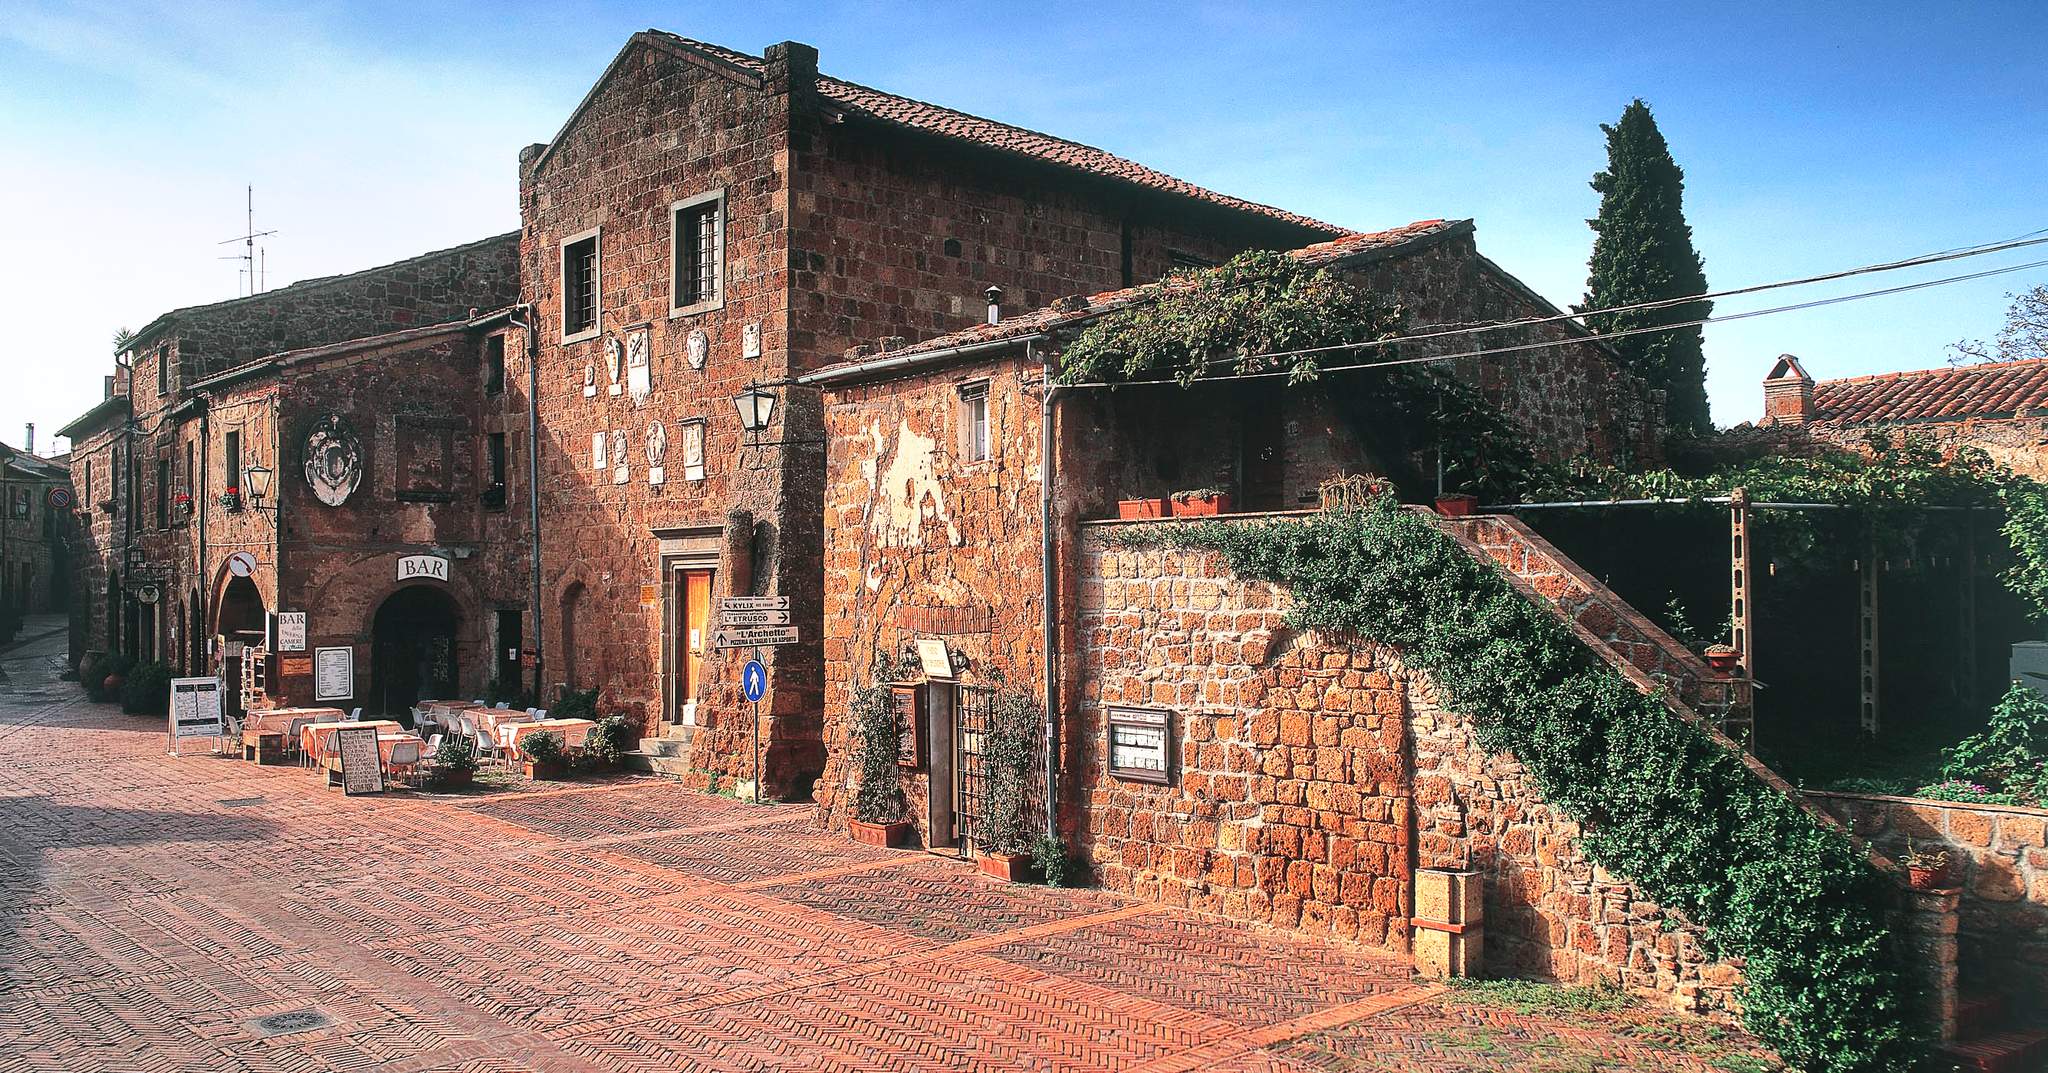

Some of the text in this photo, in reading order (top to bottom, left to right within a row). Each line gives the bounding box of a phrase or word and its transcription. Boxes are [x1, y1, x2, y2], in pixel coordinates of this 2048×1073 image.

[404, 559, 443, 577] BAR
[280, 614, 305, 624] BAR
[736, 629, 790, 638] "L'Archetto"
